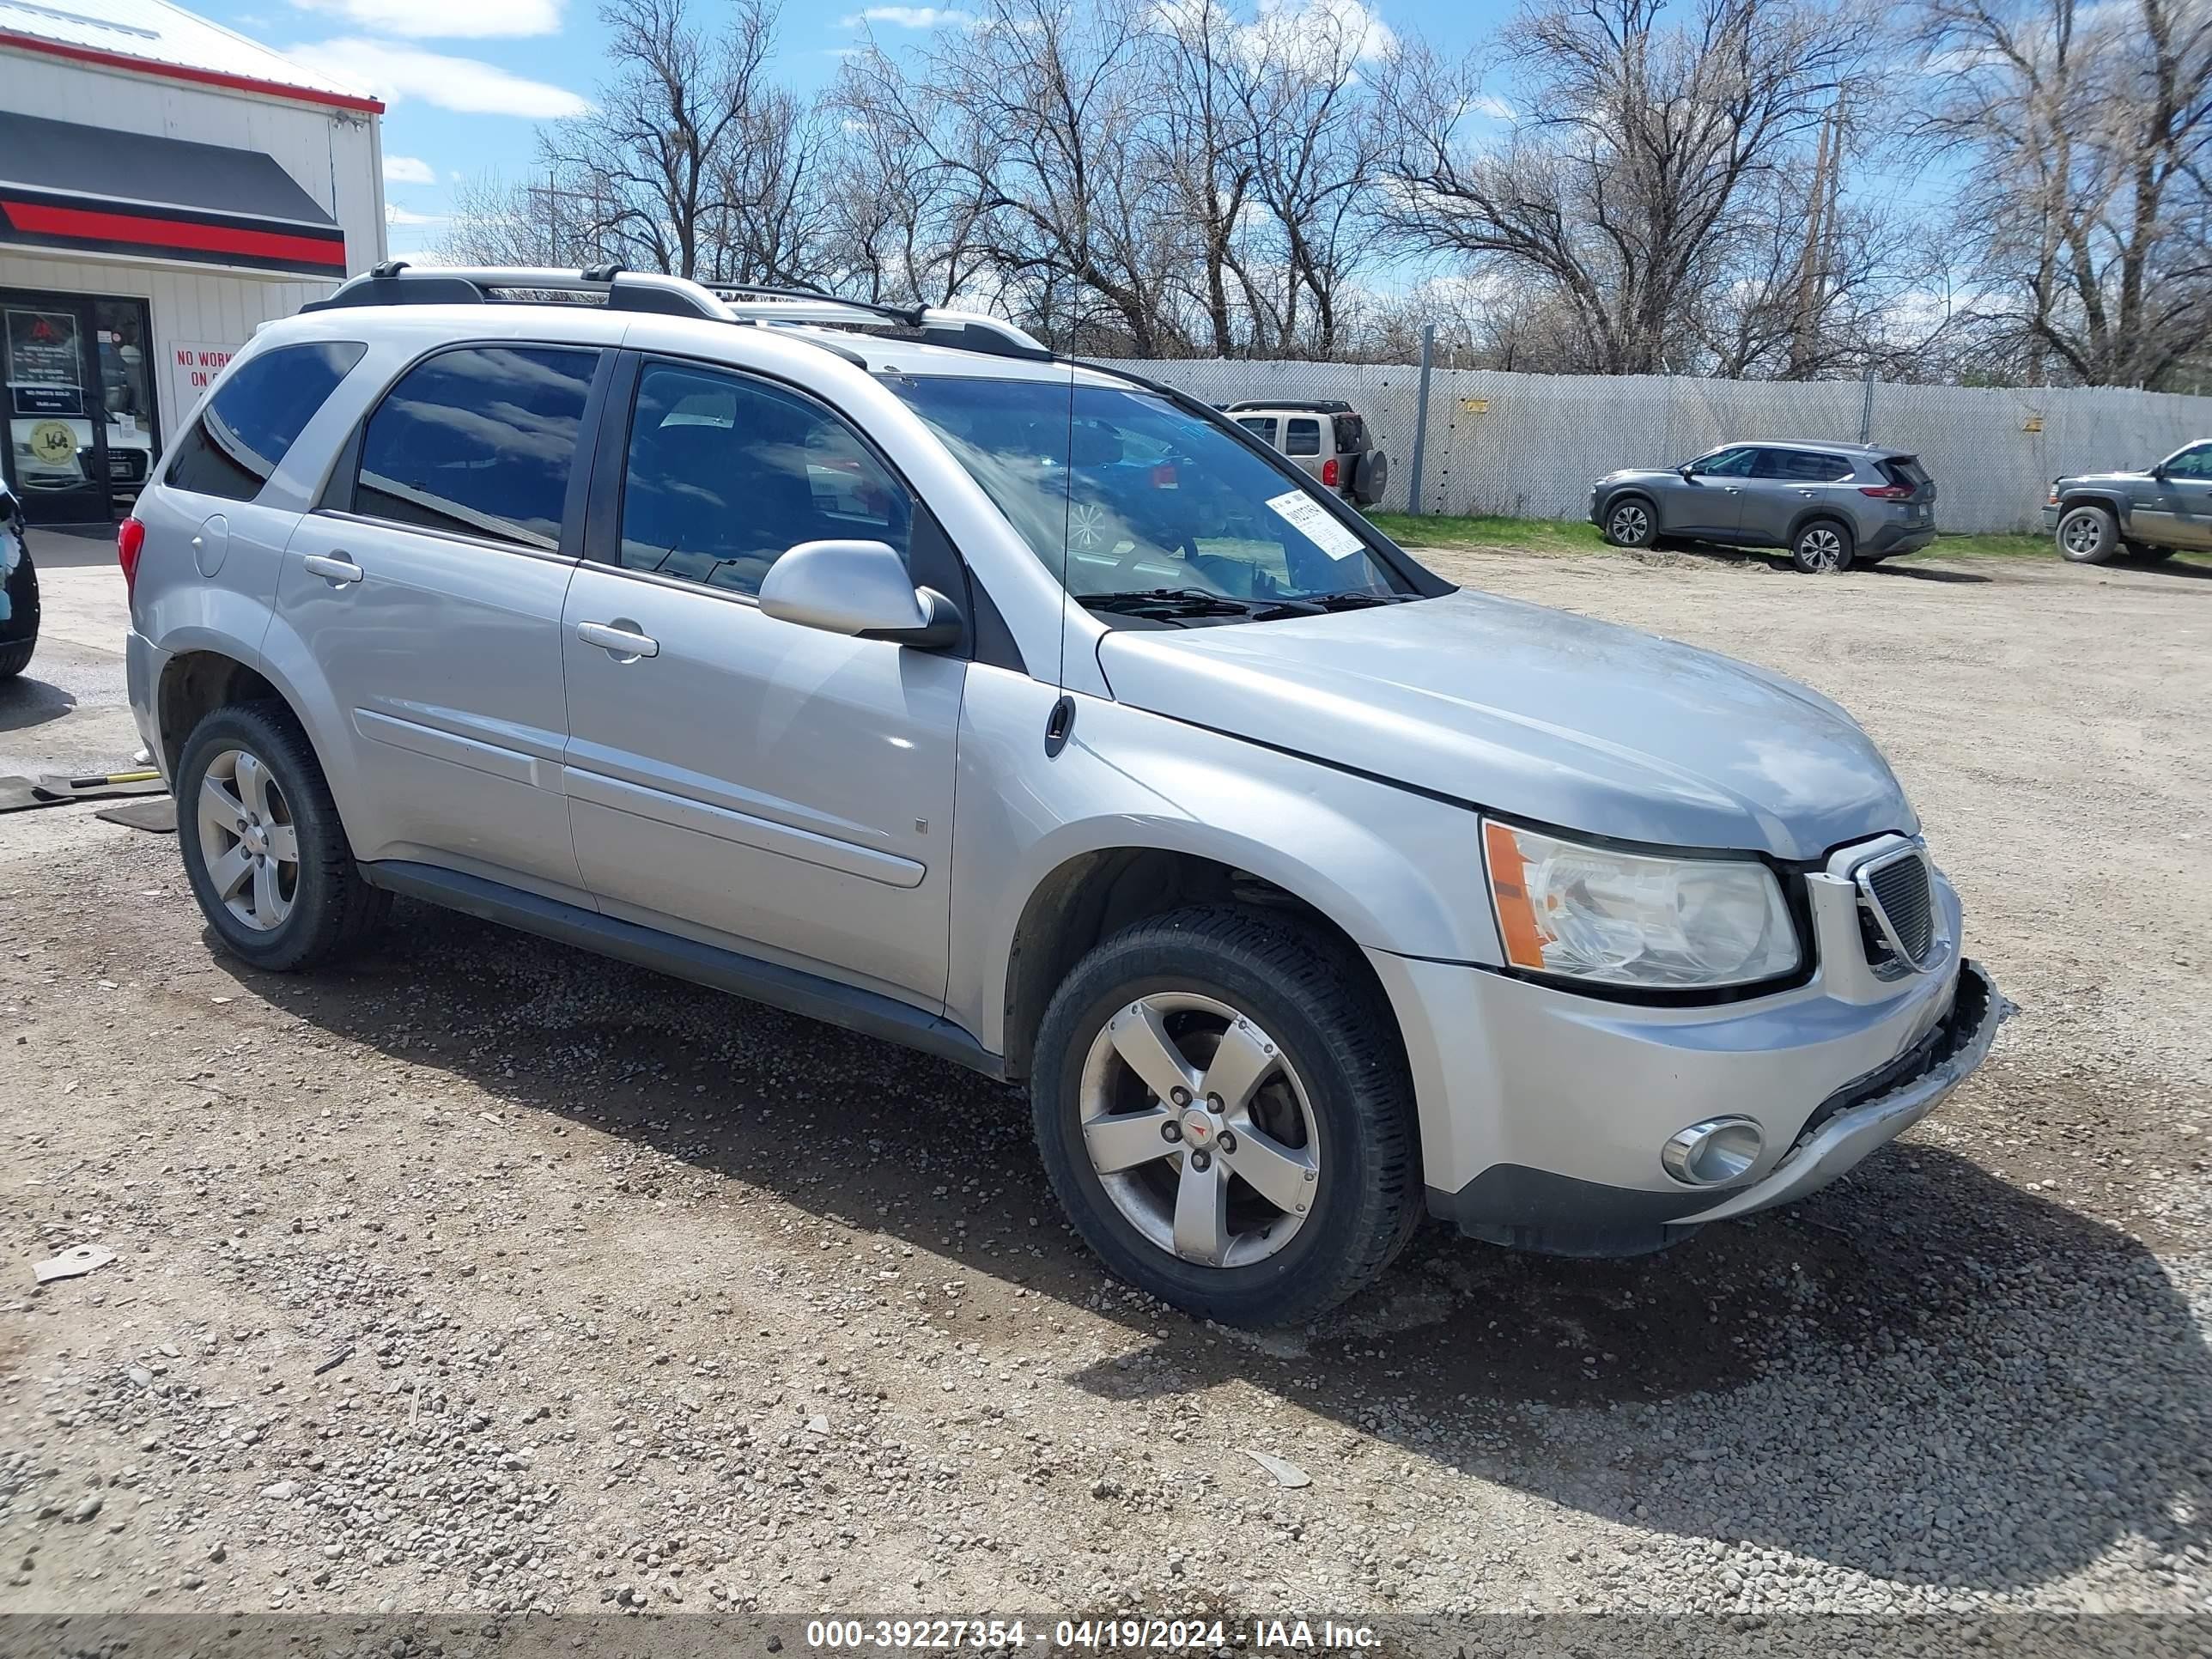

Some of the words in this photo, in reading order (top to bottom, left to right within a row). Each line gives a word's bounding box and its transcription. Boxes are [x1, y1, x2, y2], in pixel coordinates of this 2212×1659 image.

[177, 350, 193, 366] NO
[198, 351, 235, 368] WORK
[191, 371, 207, 386] ON
